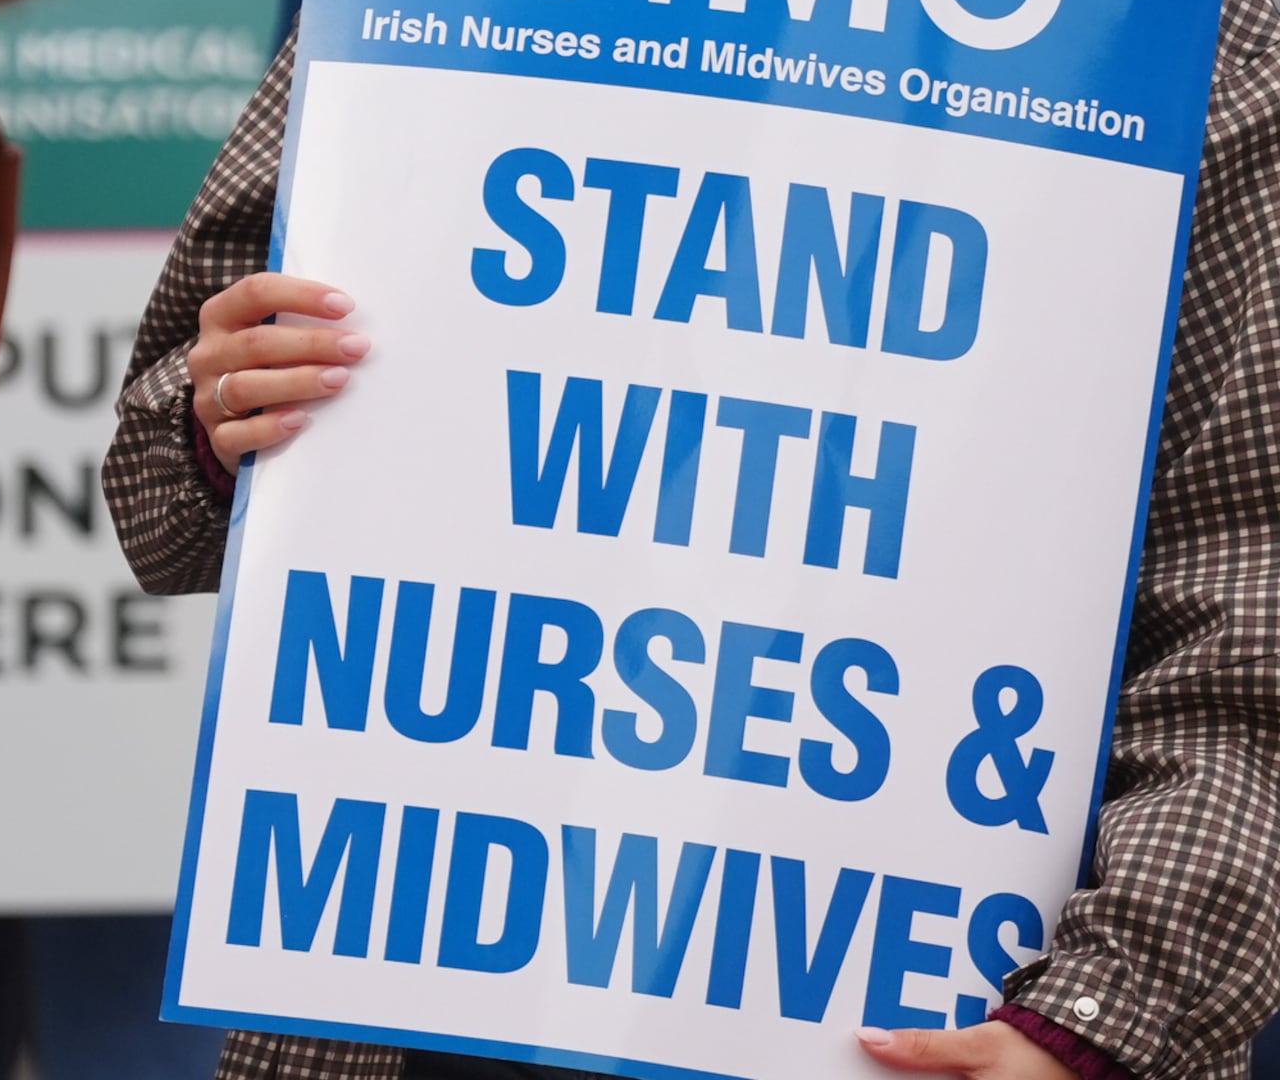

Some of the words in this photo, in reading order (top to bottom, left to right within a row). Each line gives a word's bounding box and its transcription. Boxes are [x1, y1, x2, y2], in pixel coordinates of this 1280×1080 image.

[15, 25, 265, 81] MEDICAL
[361, 8, 448, 46] Irish
[460, 15, 601, 60] Nurses
[612, 36, 689, 70] and
[700, 39, 886, 96] Midwives
[899, 67, 1145, 142] Organisation
[470, 147, 989, 362] STAND
[506, 369, 917, 580] WITH
[268, 569, 900, 803] NURSES
[945, 664, 1056, 836] &
[225, 788, 1045, 1031] MIDWIVES
